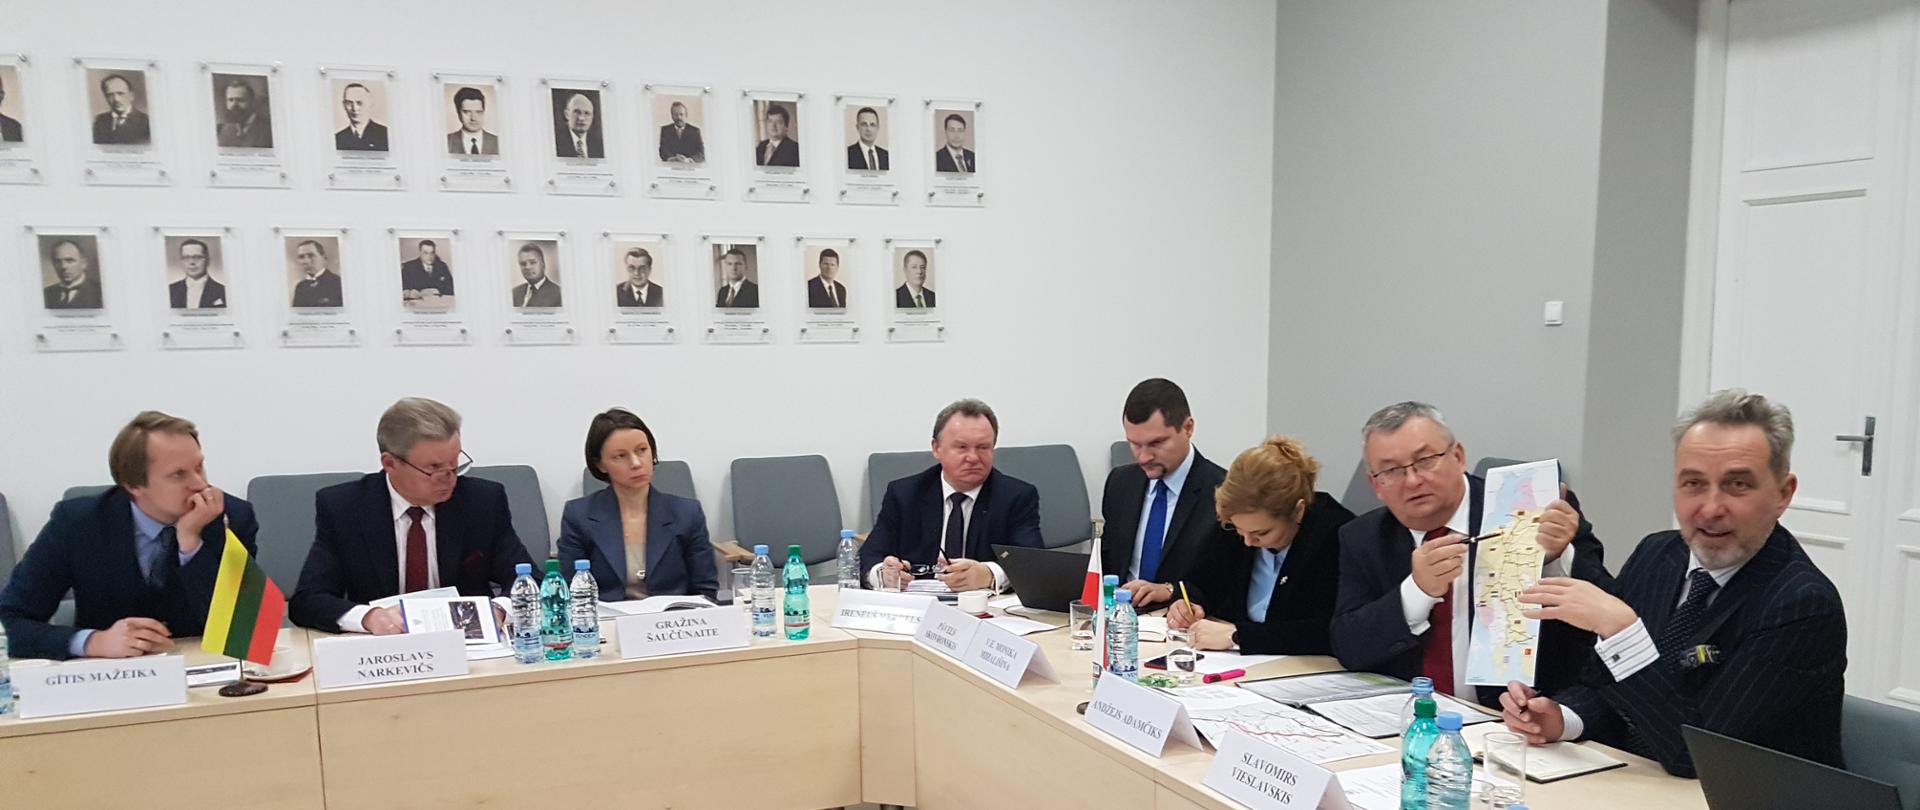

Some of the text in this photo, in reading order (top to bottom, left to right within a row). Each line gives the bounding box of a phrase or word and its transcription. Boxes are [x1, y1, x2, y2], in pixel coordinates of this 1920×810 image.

[655, 617, 708, 629] GRAŽINA
[358, 651, 434, 666] JAROSLAVS
[89, 668, 158, 681] MAŽEIKA
[357, 662, 434, 678] NARKEVIČS
[1093, 700, 1163, 740] ANDŽEJS ADAMČIKS
[1241, 752, 1299, 786] SLAVOMIRS
[1232, 766, 1294, 805] VIESLAVSKIS
